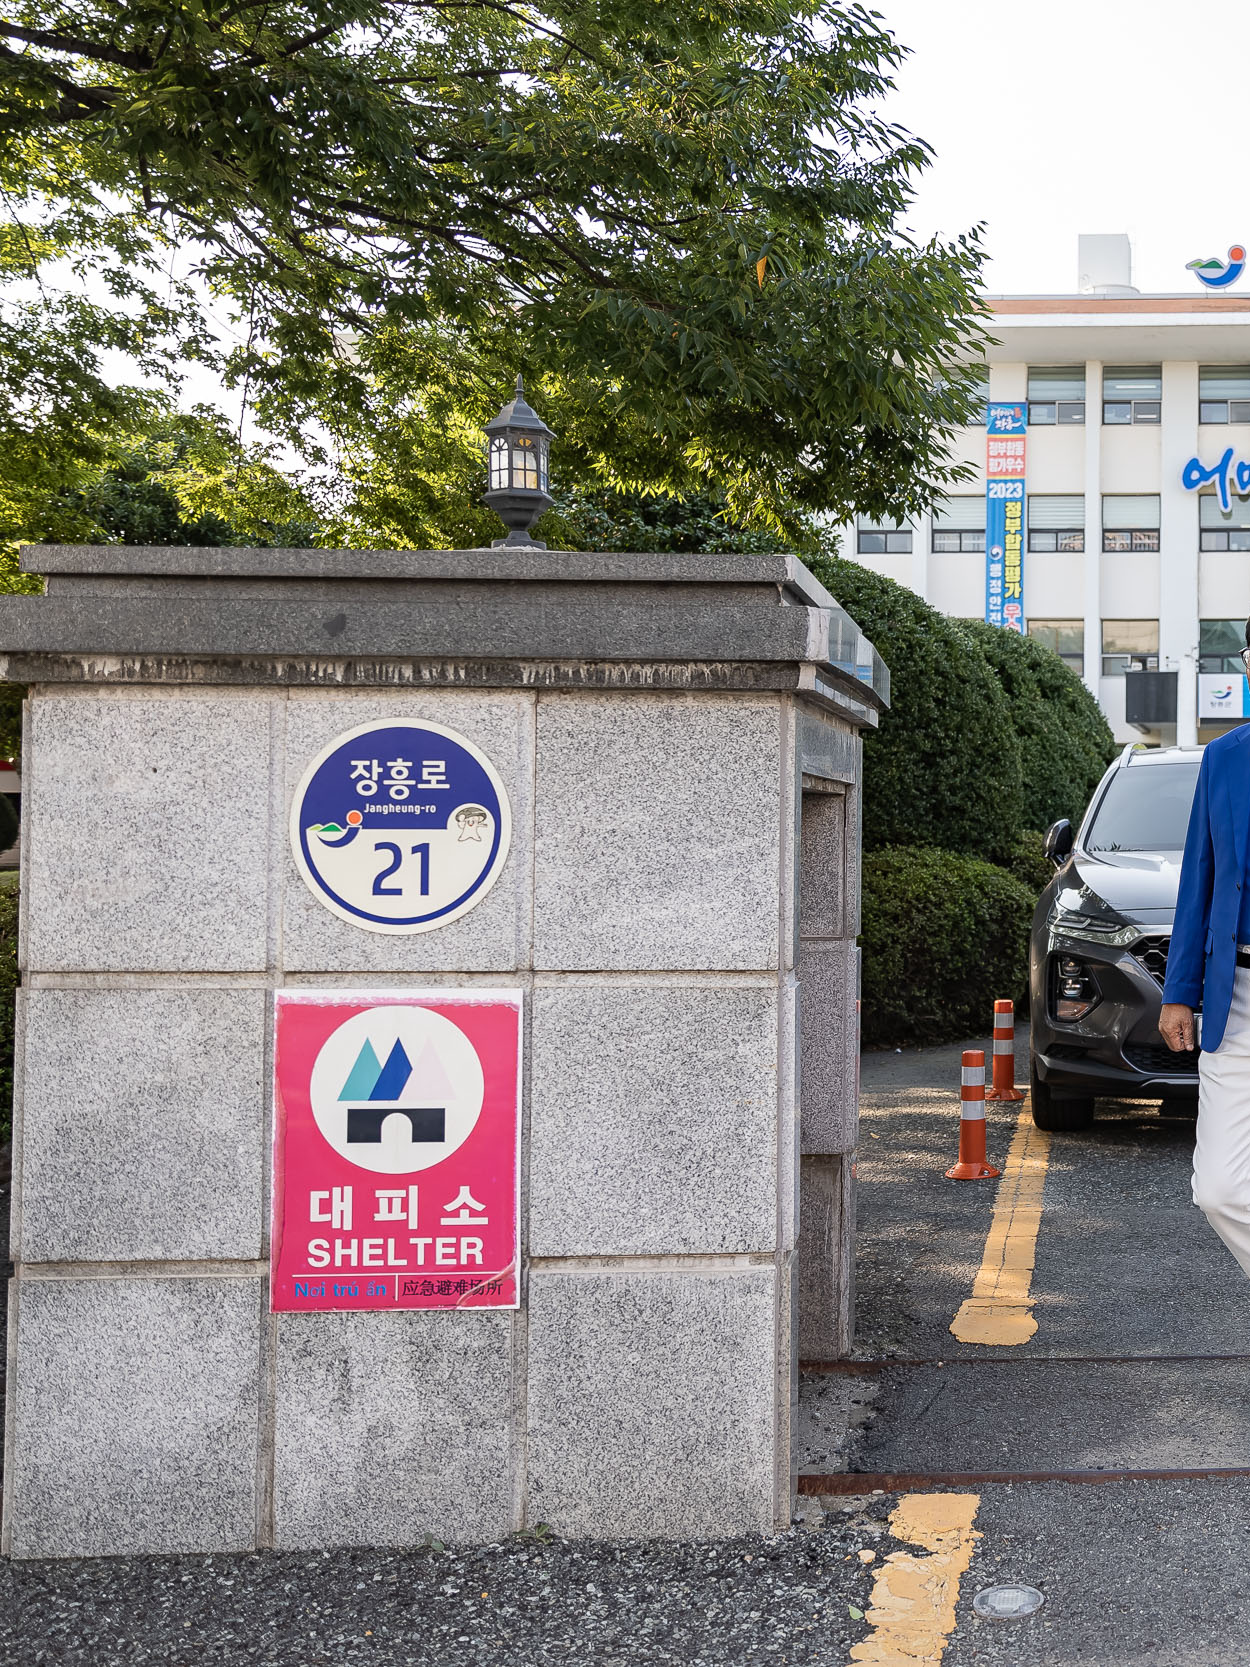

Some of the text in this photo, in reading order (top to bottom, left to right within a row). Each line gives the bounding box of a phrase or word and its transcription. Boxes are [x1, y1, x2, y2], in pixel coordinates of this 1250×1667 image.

[988, 482, 1023, 499] 2023
[350, 758, 451, 801] 장흥로
[363, 803, 437, 815] Jangheung-ro
[372, 842, 430, 896] 21
[307, 1237, 484, 1268] SHELTER
[402, 1279, 503, 1297] 应急避难场所
